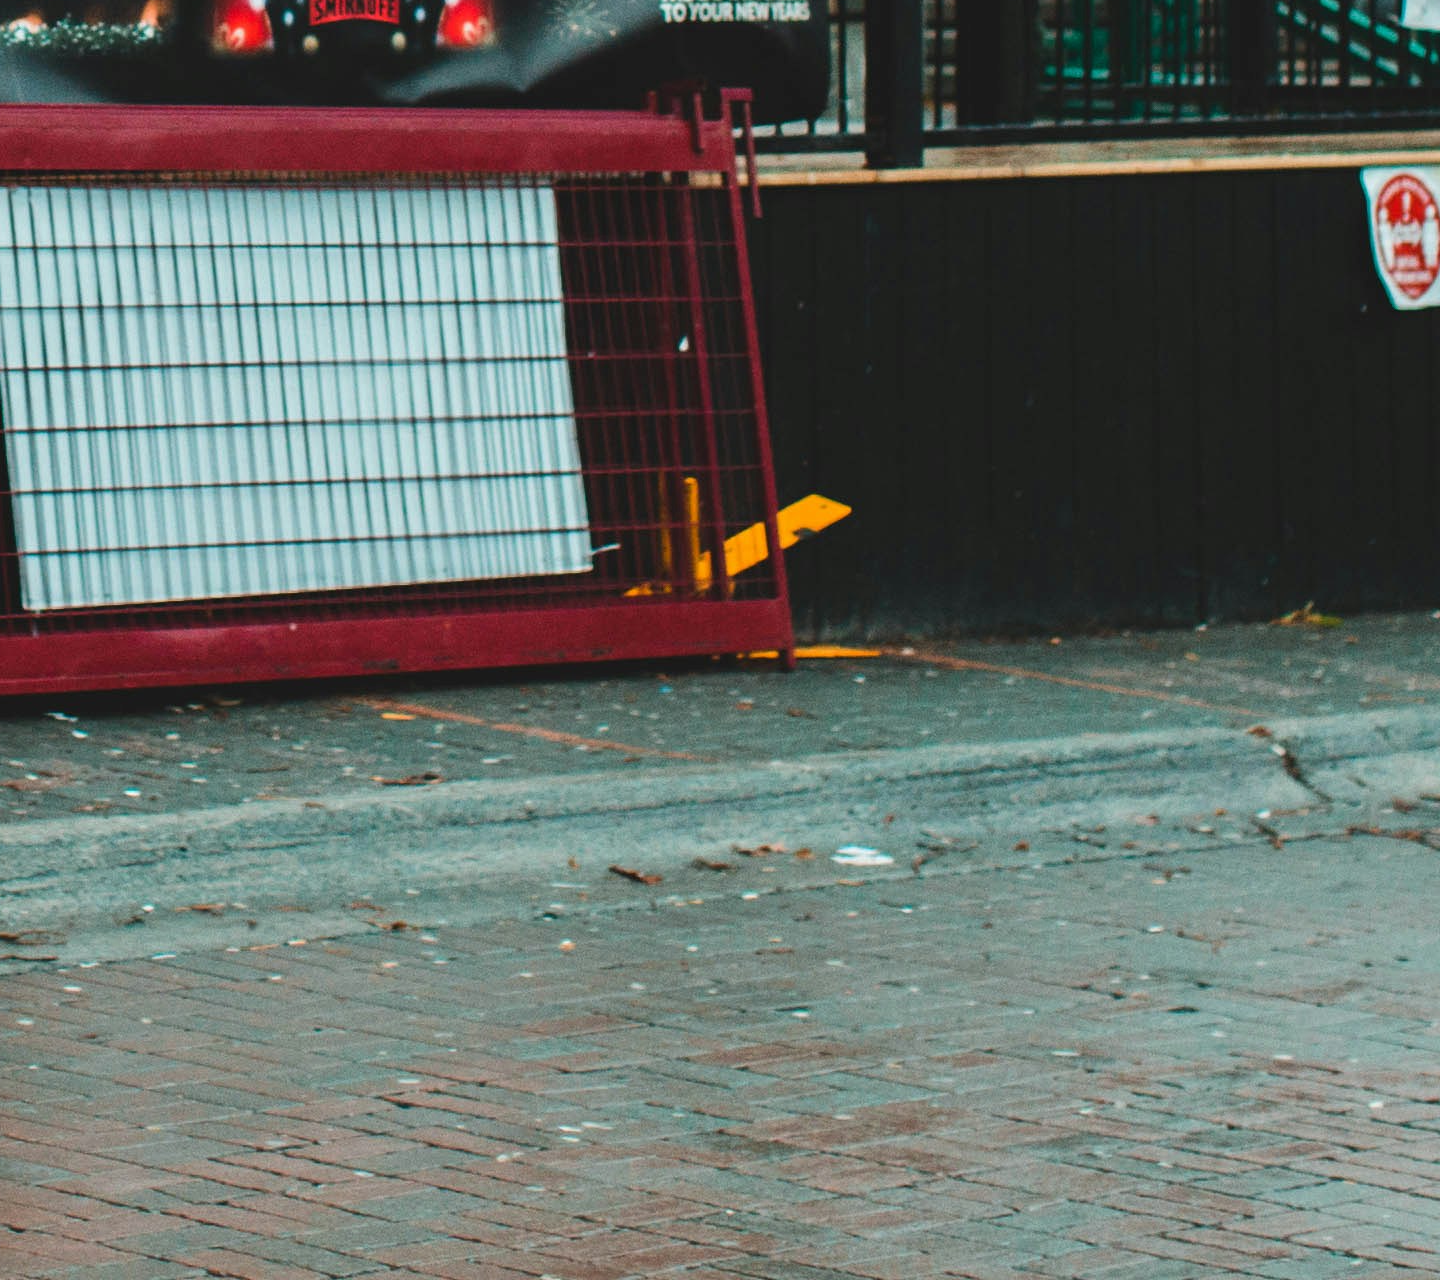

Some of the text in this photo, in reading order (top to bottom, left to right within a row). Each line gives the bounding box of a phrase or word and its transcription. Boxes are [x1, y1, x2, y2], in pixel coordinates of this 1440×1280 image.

[660, 3, 687, 23] TO
[689, 3, 734, 22] YOUR
[735, 2, 770, 21] NEW
